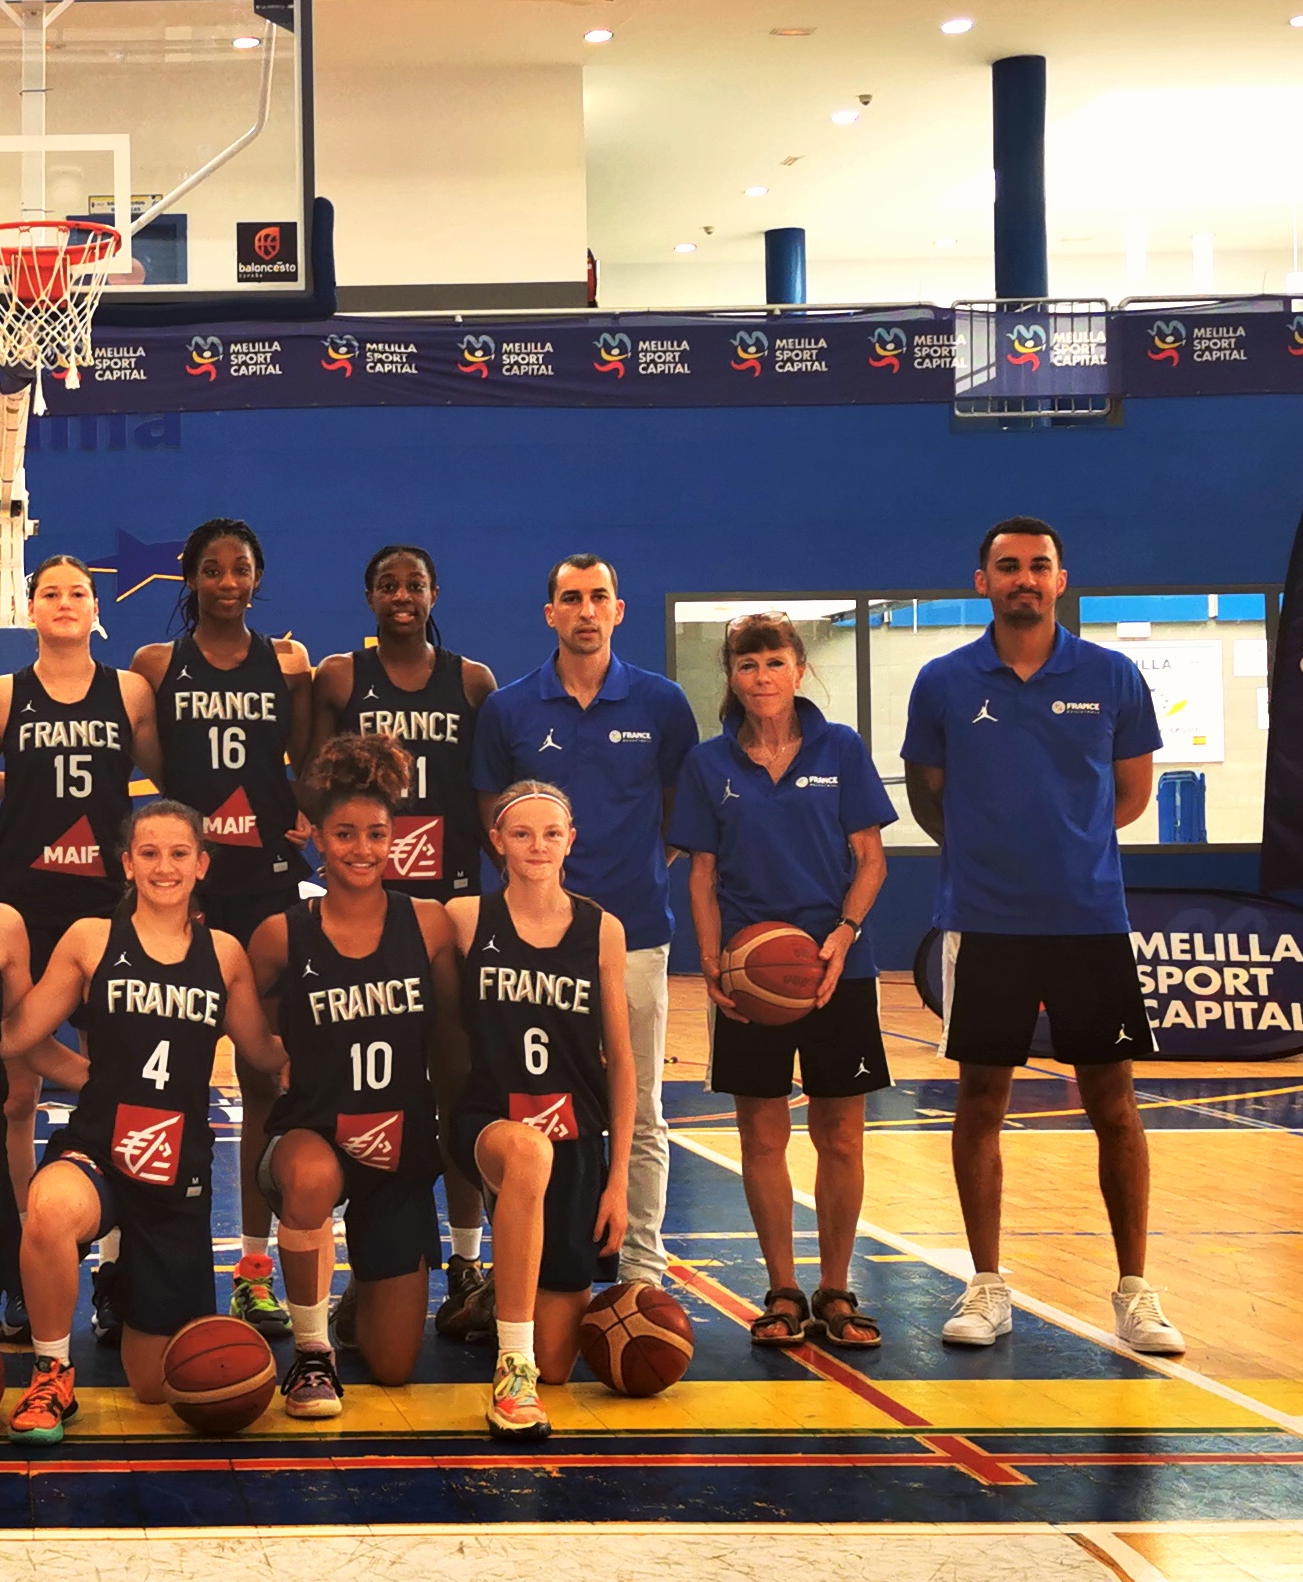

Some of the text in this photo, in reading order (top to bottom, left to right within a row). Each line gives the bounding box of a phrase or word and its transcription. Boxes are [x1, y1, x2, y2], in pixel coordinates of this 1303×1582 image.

[1053, 331, 1107, 344] MELILLA
[1193, 327, 1246, 338] MELILLA
[639, 341, 690, 351] MELILLA
[776, 338, 828, 349] MELILLA
[914, 334, 967, 346] MELILLA
[1194, 339, 1236, 350] SPORT
[95, 347, 146, 357] MELILLA
[230, 342, 282, 353] MELILLA
[366, 343, 418, 352] MELILLA
[502, 343, 554, 352] MELILLA
[914, 345, 958, 357] SPORT
[1053, 343, 1099, 355] SPORT
[231, 353, 273, 364] SPORT
[367, 352, 408, 362] SPORT
[502, 354, 545, 364] SPORT
[639, 352, 681, 362] SPORT
[776, 350, 818, 360] SPORT
[1052, 354, 1108, 366] CAPITAL
[1194, 350, 1248, 361] CAPITAL
[95, 358, 137, 369] SPORT
[366, 363, 418, 373] CAPITAL
[639, 364, 691, 374] CAPITAL
[775, 361, 828, 372] CAPITAL
[914, 357, 968, 369] CAPITAL
[95, 370, 147, 381] CAPITAL
[231, 364, 283, 376] CAPITAL
[503, 365, 554, 375] CAPITAL
[174, 691, 277, 722] FRANCE
[359, 710, 460, 744] FRANCE
[19, 720, 121, 752] FRANCE
[208, 726, 246, 770] 16
[54, 755, 92, 798] 15
[400, 756, 427, 798] 1
[202, 815, 257, 835] MAIF
[43, 845, 100, 864] MAIF
[1132, 931, 1303, 962] MELILLA
[1137, 965, 1274, 996] SPORT
[479, 966, 591, 1015] FRANCE
[107, 979, 221, 1028] FRANCE
[308, 977, 425, 1026] FRANCE
[523, 1027, 549, 1075] 6
[141, 1040, 170, 1090] 4
[350, 1041, 393, 1091] 10
